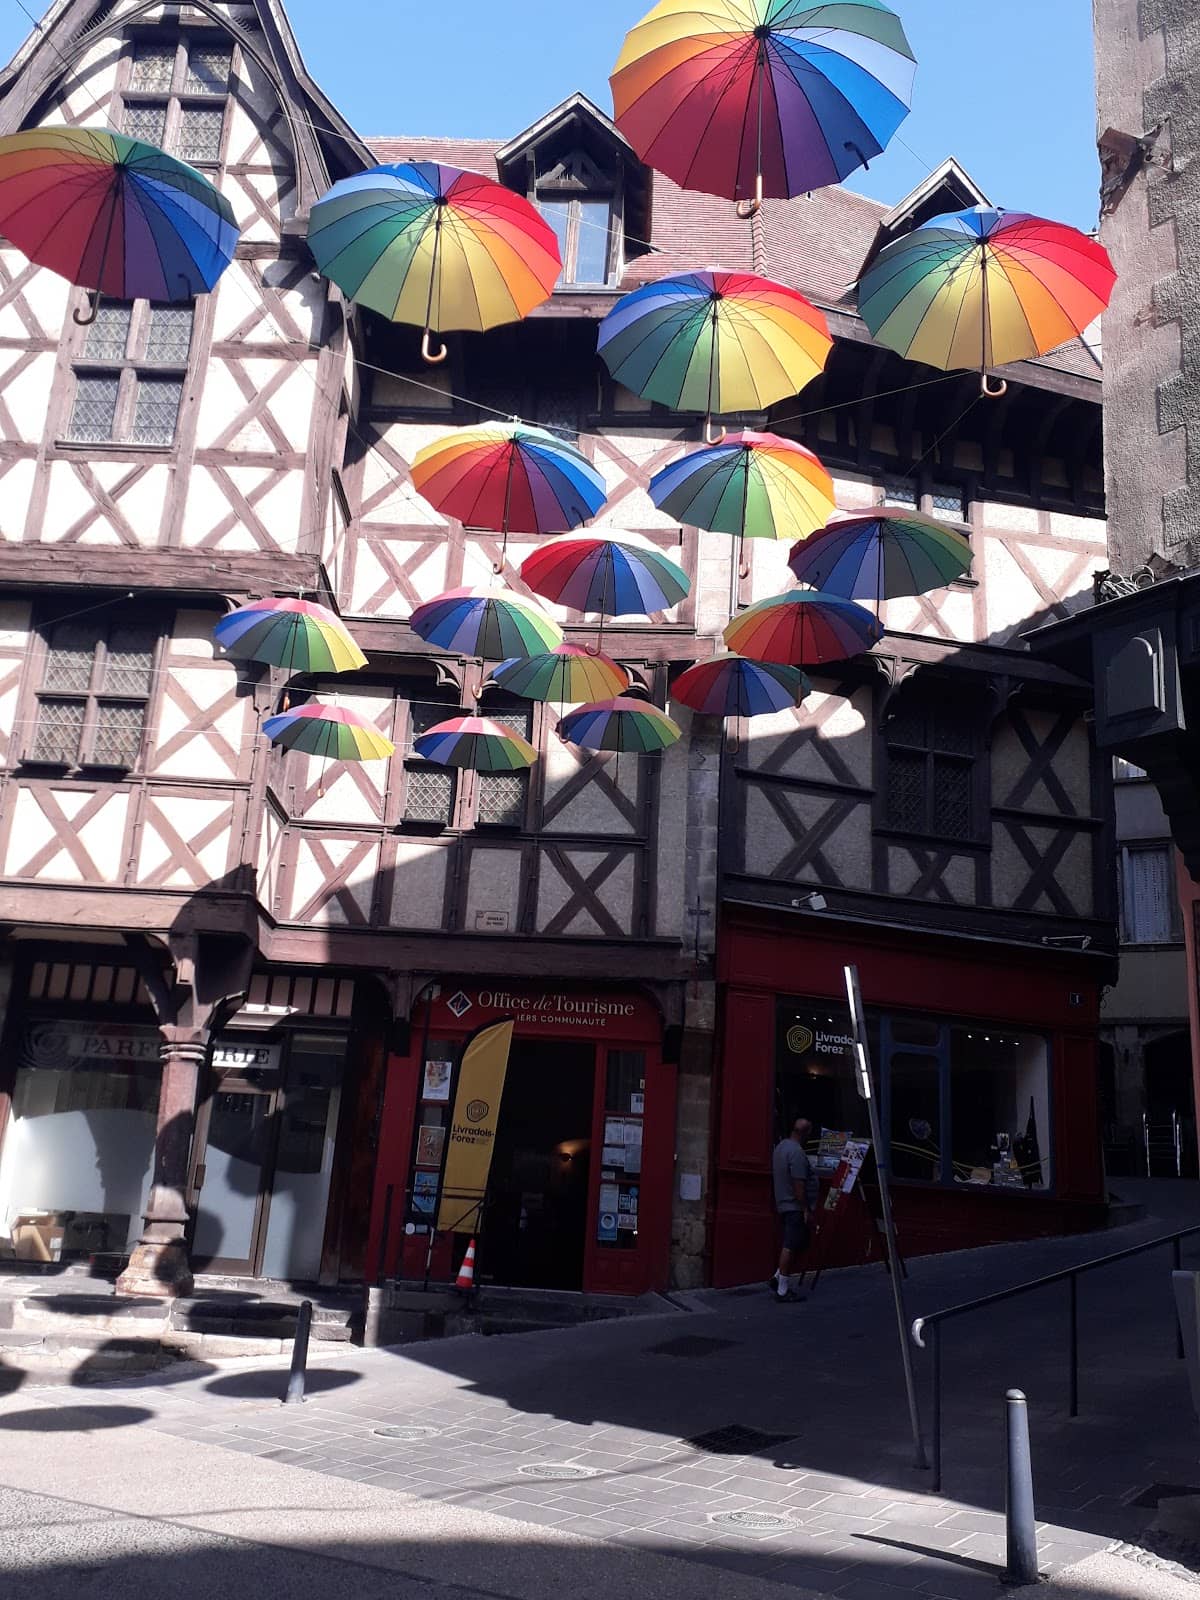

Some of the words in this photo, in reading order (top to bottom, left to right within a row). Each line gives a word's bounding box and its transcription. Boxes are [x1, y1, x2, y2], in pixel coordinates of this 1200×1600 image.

[478, 990, 530, 1010] Office
[533, 994, 553, 1010] de
[553, 994, 635, 1016] Tourisme
[815, 1031, 854, 1046] Livrado
[815, 1041, 845, 1055] Forez
[452, 1133, 476, 1144] Forez
